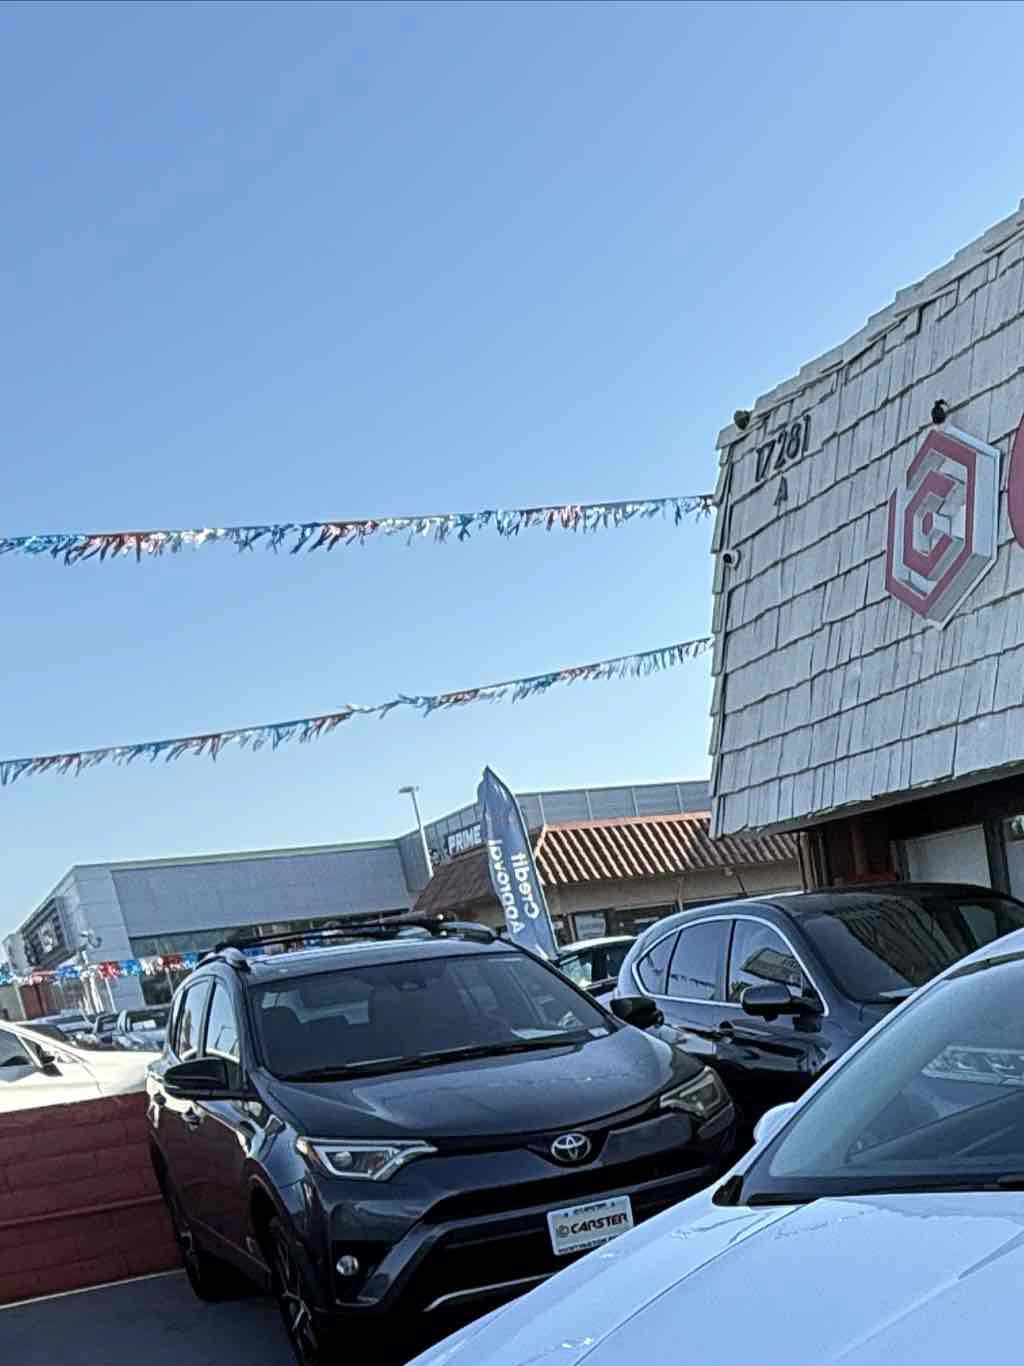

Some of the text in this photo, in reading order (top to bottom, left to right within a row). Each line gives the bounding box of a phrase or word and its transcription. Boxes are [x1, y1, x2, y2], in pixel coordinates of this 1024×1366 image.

[756, 414, 811, 482] 17281
[447, 824, 483, 857] PRIME
[571, 1212, 630, 1234] CARSTER
